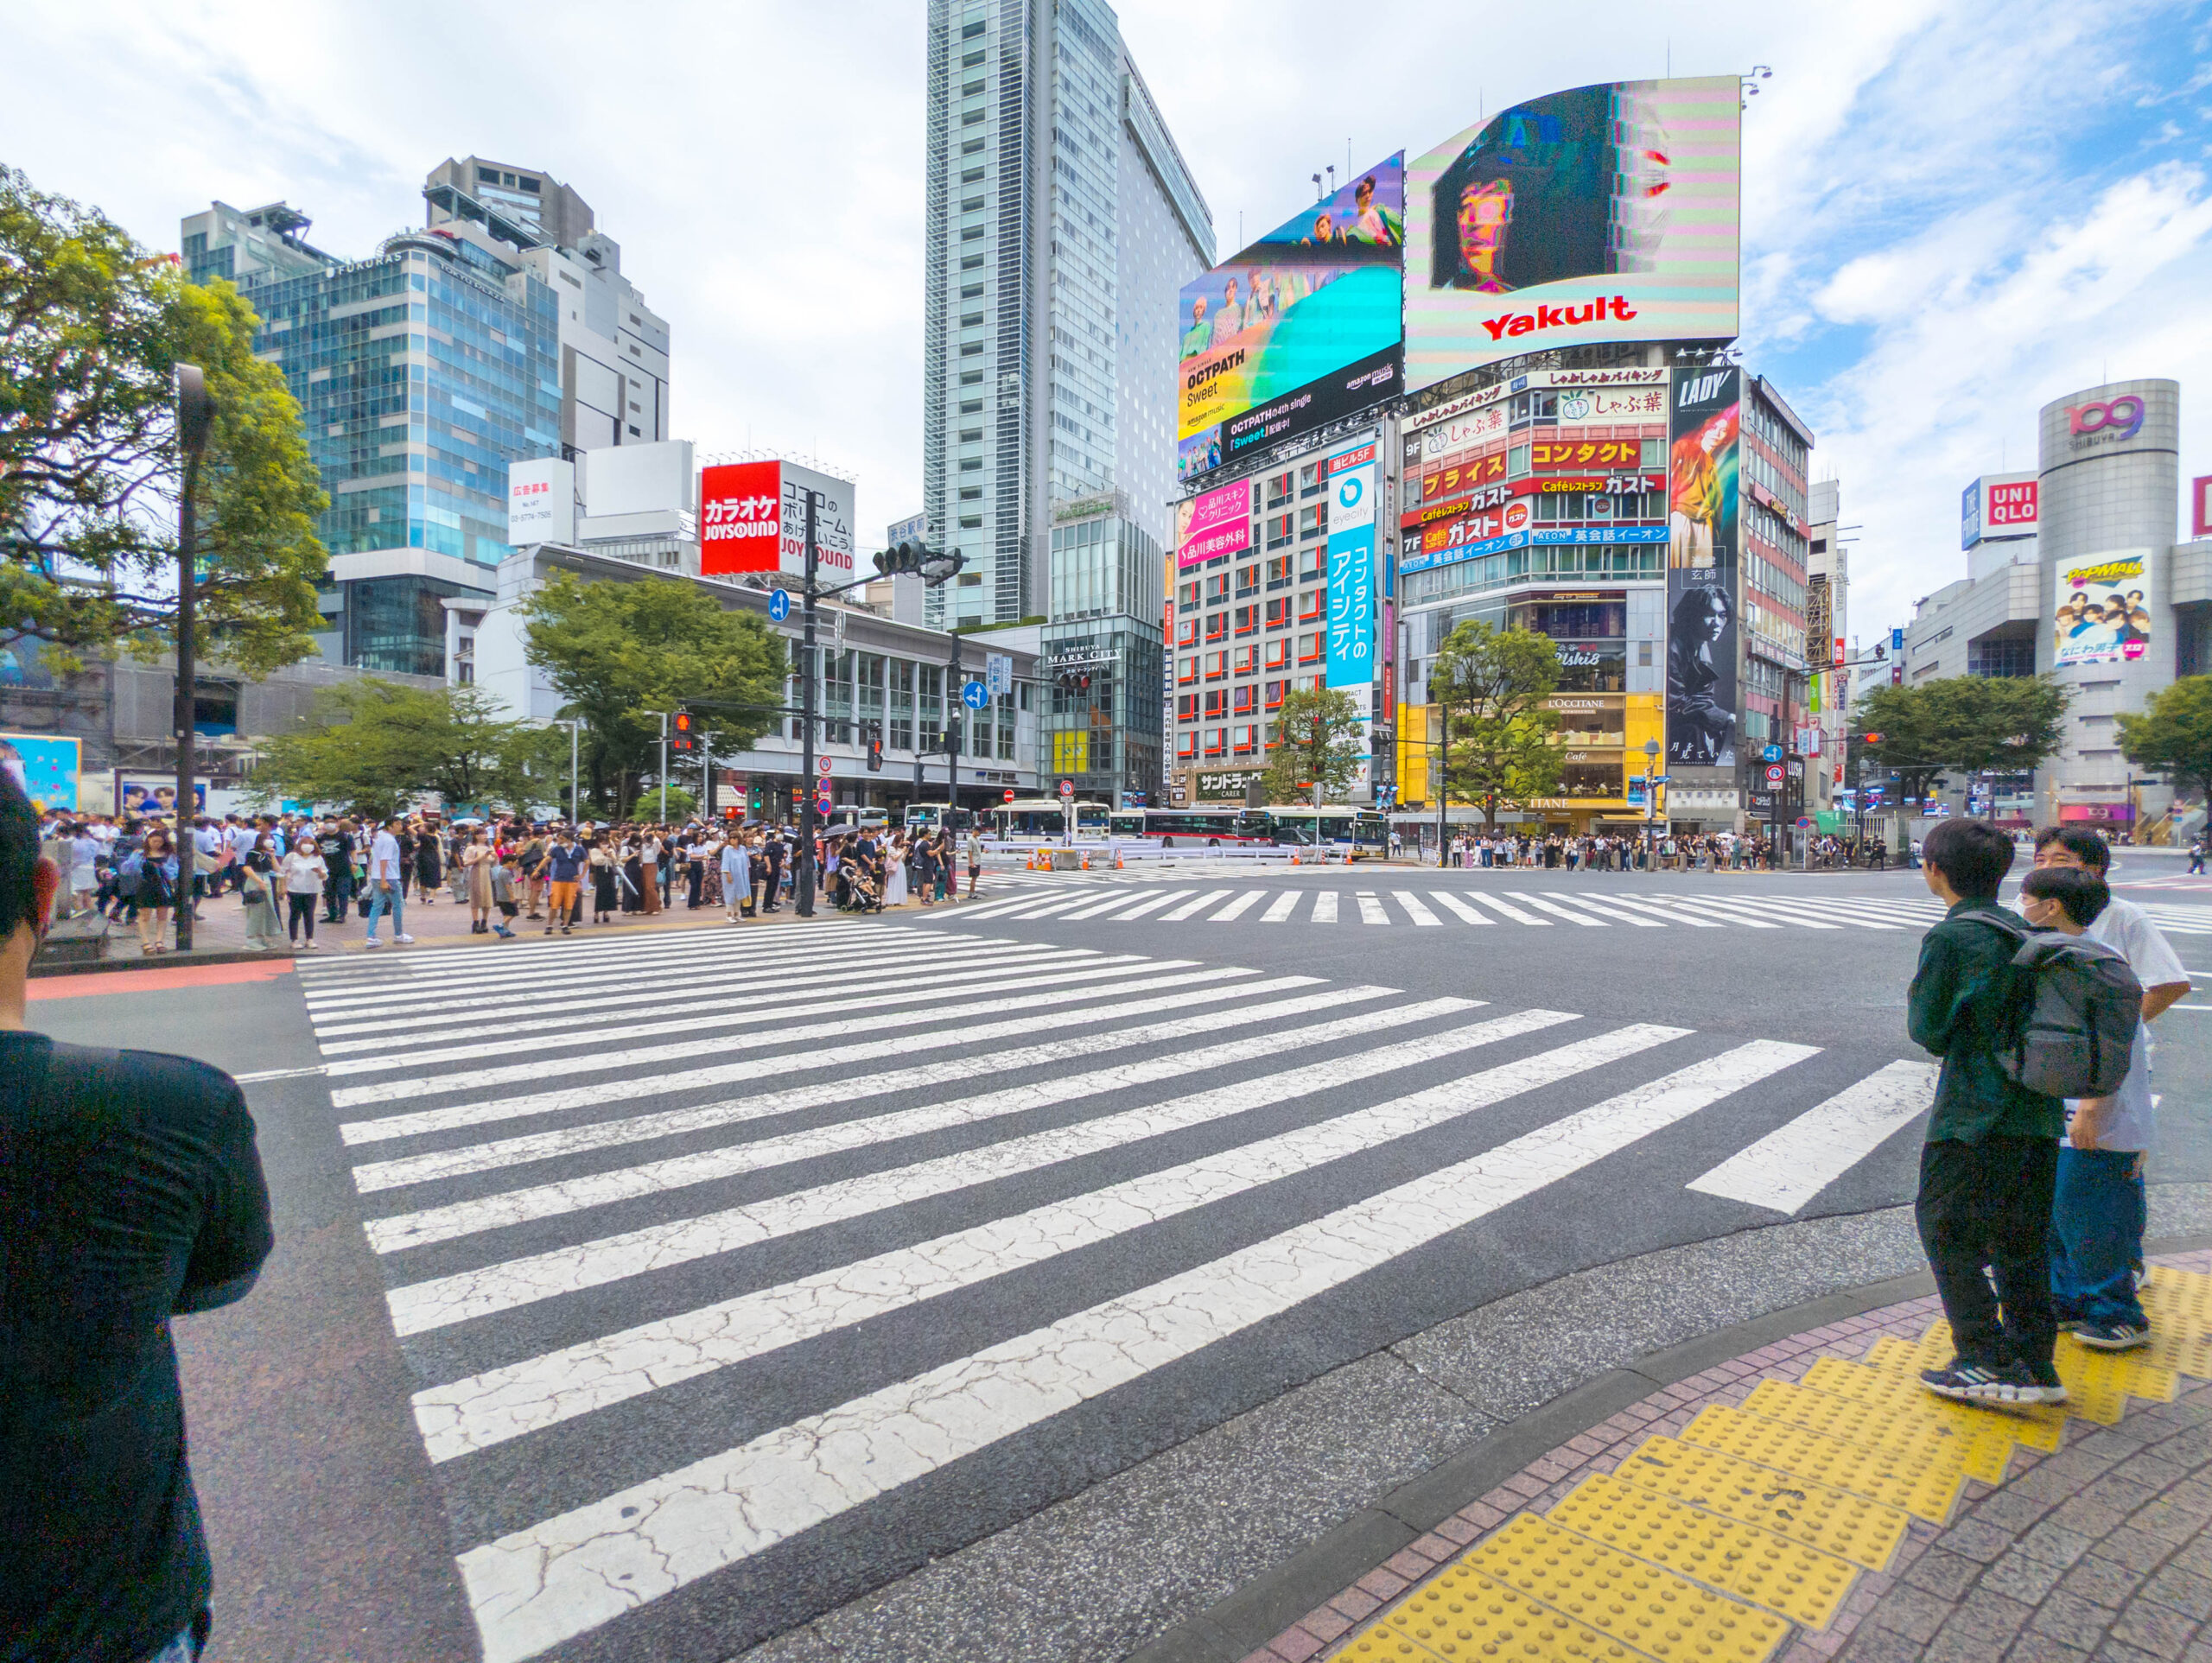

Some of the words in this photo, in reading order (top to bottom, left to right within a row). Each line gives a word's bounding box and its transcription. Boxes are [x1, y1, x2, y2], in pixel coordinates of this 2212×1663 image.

[338, 251, 402, 276] FUKURAS
[1481, 295, 1638, 341] Yakult
[1187, 348, 1245, 390] OCTPATH
[1346, 373, 1371, 390] amazon
[1371, 363, 1394, 378] music
[1550, 369, 1664, 385] しゃぶしゃぶバイキング
[1187, 381, 1217, 407] Sweet
[1679, 371, 1726, 408] LADY
[1230, 403, 1289, 435] OCTPATHの4th
[1290, 393, 1312, 410] single
[1414, 385, 1502, 427] しゃぶしゃぶバイキング
[1596, 390, 1663, 415] しゃぶ葉
[1187, 412, 1207, 426] amazon
[1452, 409, 1503, 442] しゃぶ葉
[2063, 395, 2145, 441] 109
[1406, 441, 1421, 457] 9F
[2068, 432, 2115, 450] SHIBUYA
[1332, 447, 1370, 472] 当ビル5F
[1533, 442, 1637, 464] コンタクト
[1424, 455, 1504, 496] プライス
[1605, 476, 1656, 494] ガスト
[513, 482, 549, 498] 広告募集
[1208, 487, 1246, 511] 品川スキン
[1471, 486, 1513, 512] ガスト
[1994, 486, 2031, 504] UNI
[705, 495, 777, 524] カラオケ
[1208, 501, 1242, 521] クリニック
[1333, 506, 1369, 526] eyecity
[1508, 513, 1527, 524] ガスト
[1993, 503, 2035, 523] QLO
[704, 520, 778, 542] JOYSOUND
[783, 522, 854, 553] あげいこう。
[1426, 528, 1446, 542] Café
[1447, 516, 1499, 547] ガスト
[1537, 530, 1567, 541] AEON
[1575, 529, 1667, 542] 英会話イーオン
[781, 537, 853, 570] JOYOUND
[1187, 528, 1245, 560] 品川美容外科
[1404, 536, 1421, 553] 7F
[1432, 540, 1505, 566] 英会話イーオン
[1691, 568, 1717, 581] 玄師
[1332, 549, 1352, 661] アイシティ
[1353, 546, 1368, 658] コンタクトの
[1047, 653, 1084, 664] MARK
[1090, 649, 1122, 659] CITY
[1065, 644, 1101, 653] SHIBUYA
[1548, 698, 1605, 708] L'OCCITANE
[1564, 751, 1587, 761] Café
[1788, 760, 1803, 778] LUSH
[2088, 807, 2108, 819] 109
